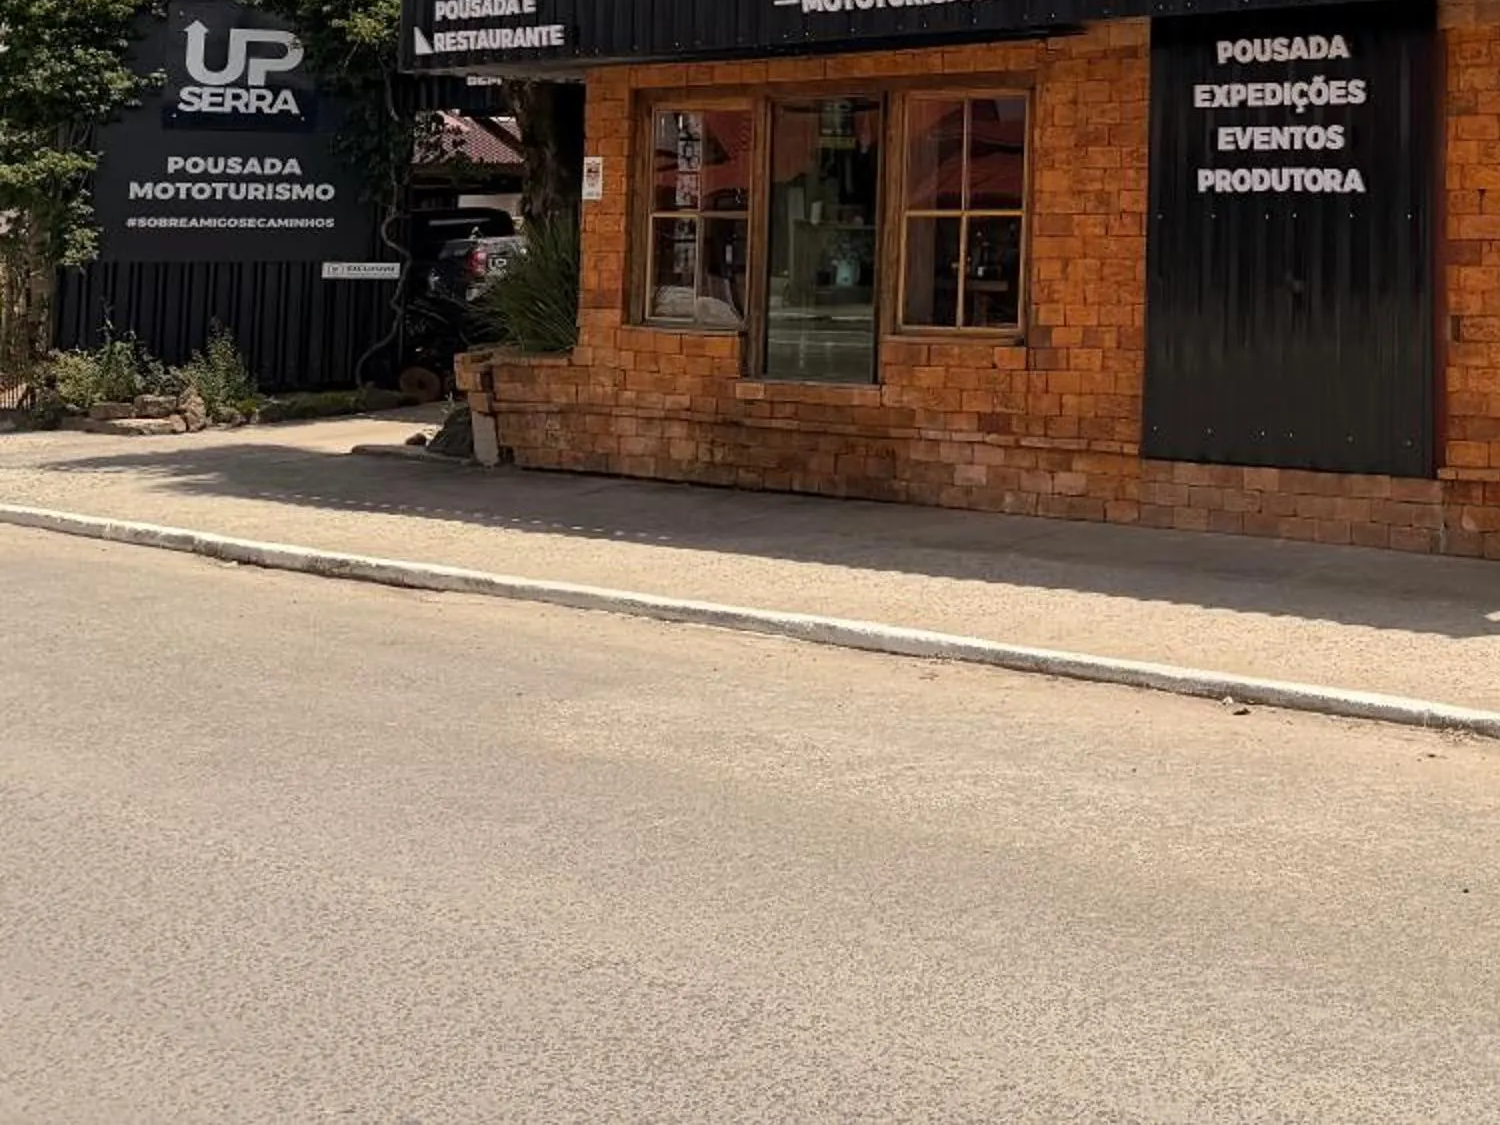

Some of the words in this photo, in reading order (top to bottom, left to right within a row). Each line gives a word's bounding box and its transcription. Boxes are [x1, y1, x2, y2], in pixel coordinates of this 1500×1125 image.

[433, 25, 565, 53] RESTAURANTE
[1216, 35, 1351, 64] POUSADA
[184, 20, 304, 87] UP
[178, 86, 300, 115] SERRA
[1194, 75, 1367, 113] EXPEDIÇÕES
[1217, 124, 1346, 151] EVENTOS
[167, 156, 302, 175] POUSADA
[128, 181, 335, 201] MOTOTURISMO
[1197, 168, 1367, 193] PRODUTORA
[126, 217, 335, 228] #SOBREAMIGOSECAMINHOS
